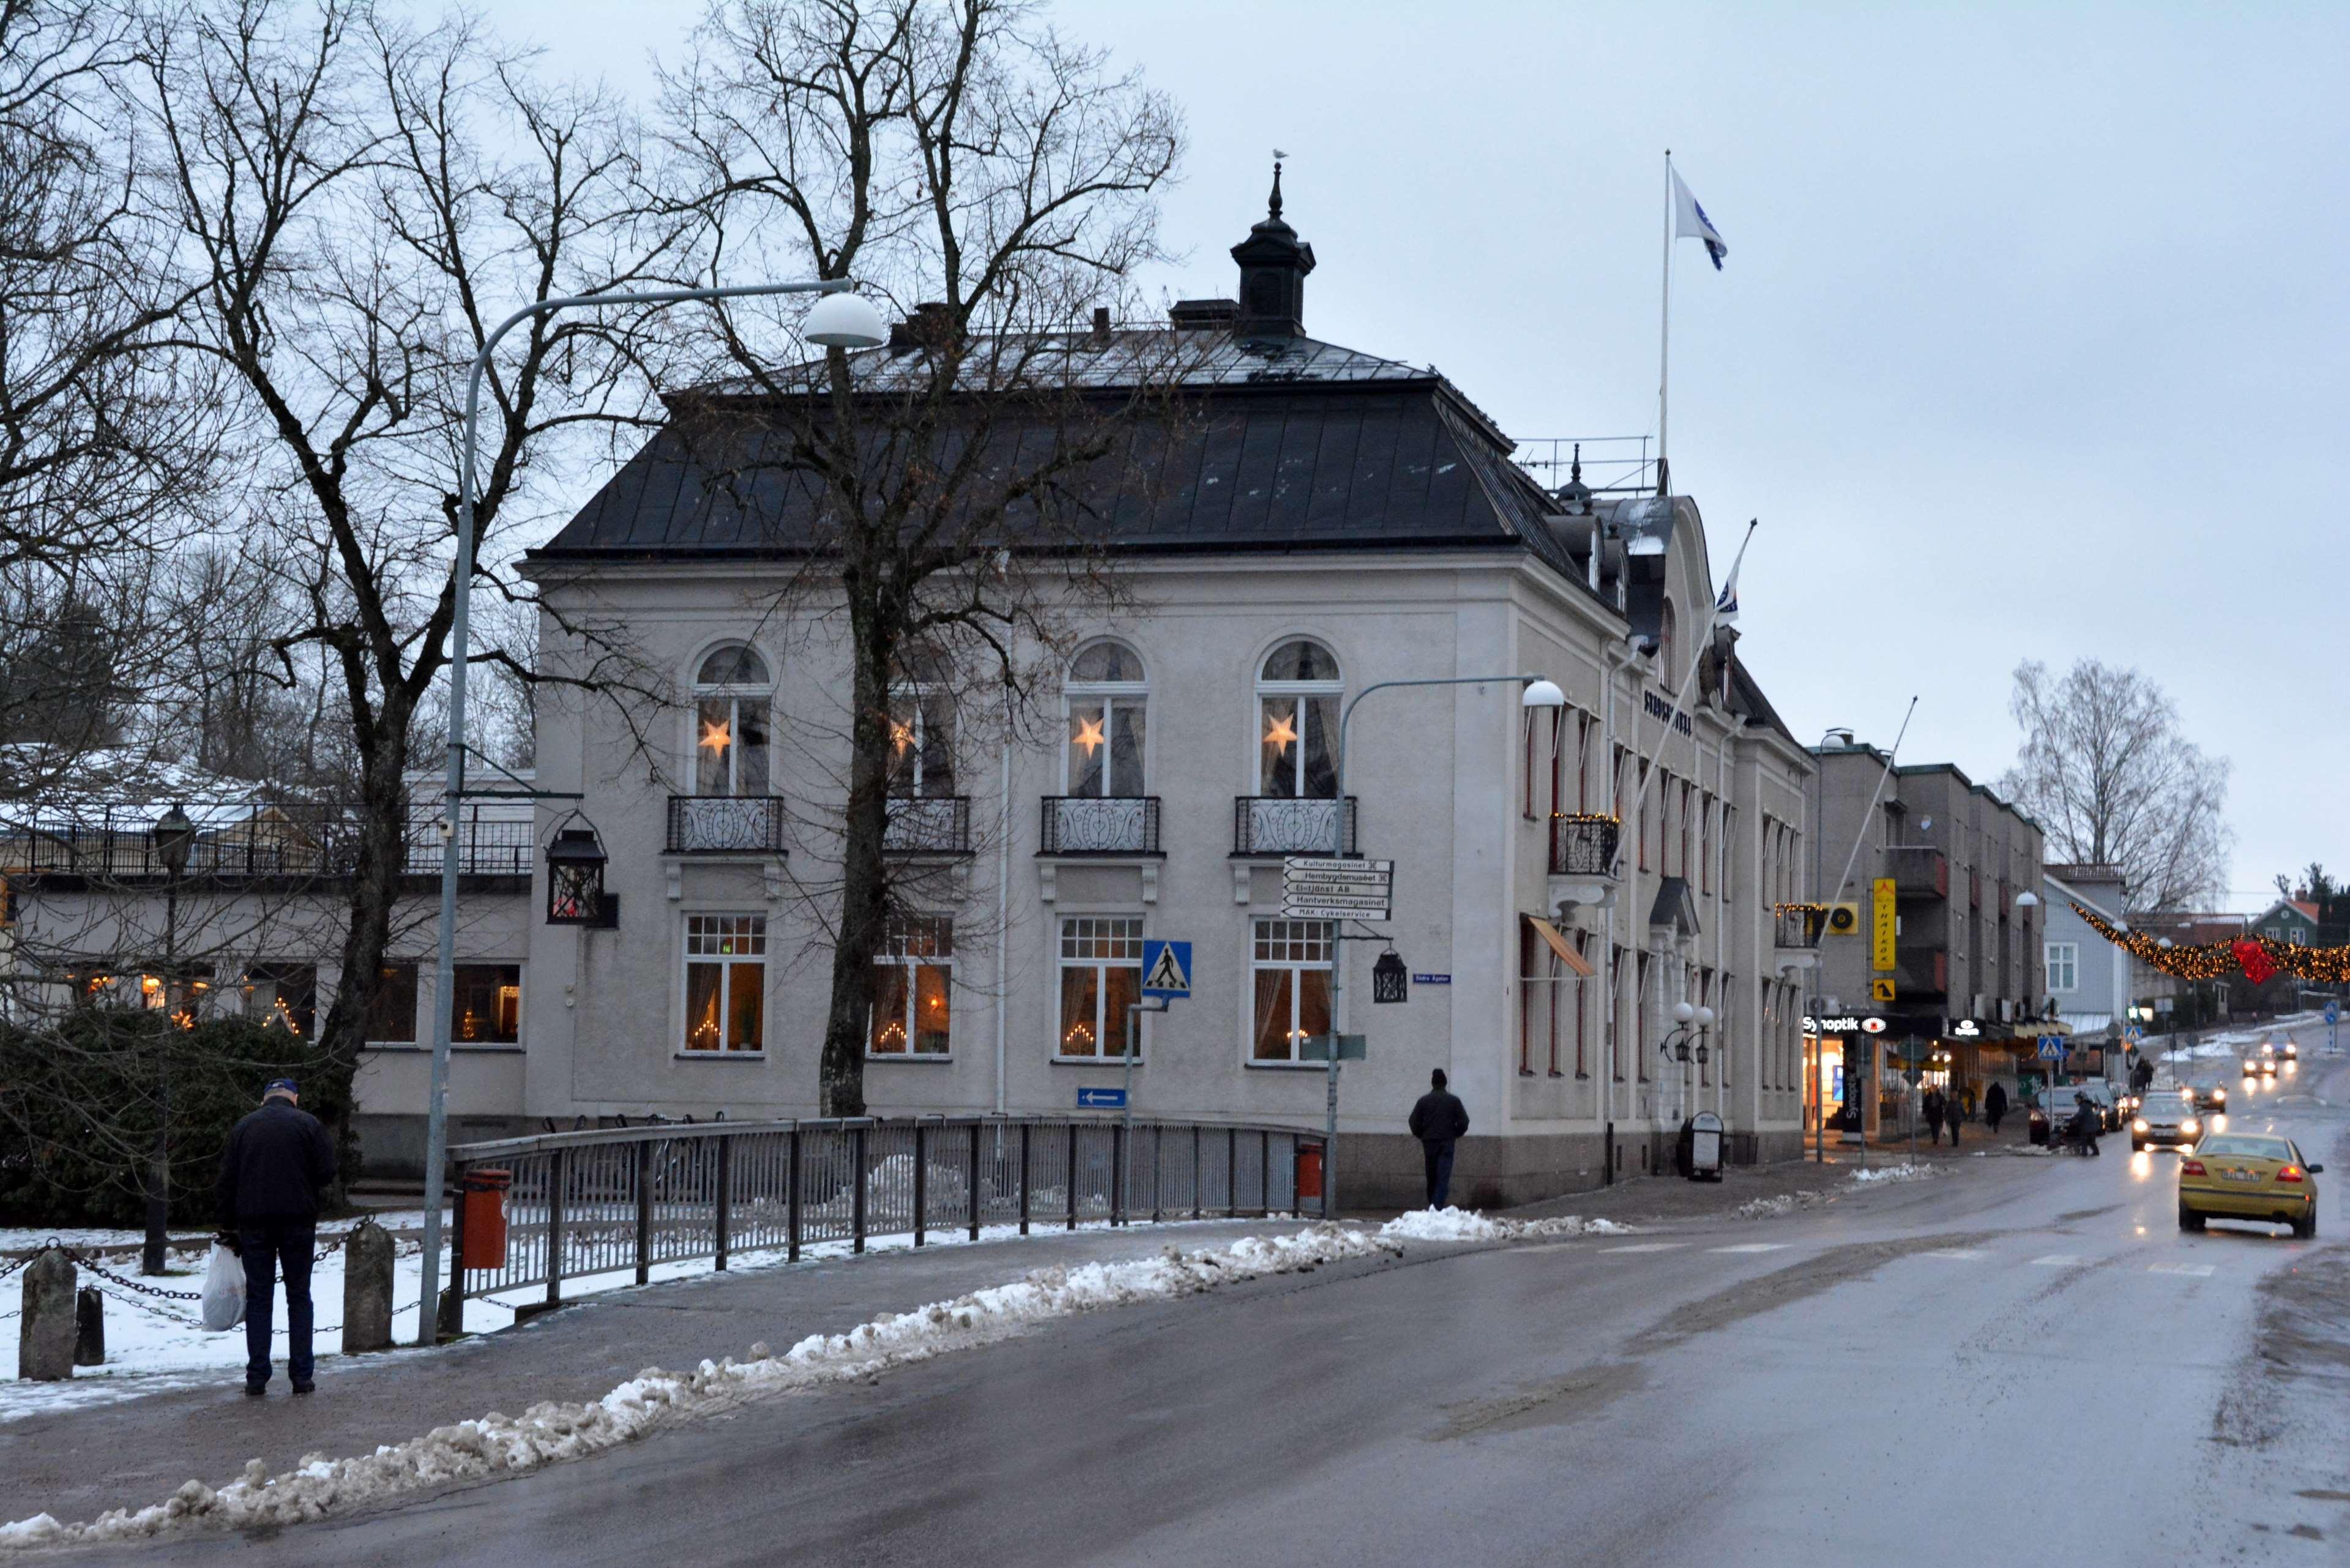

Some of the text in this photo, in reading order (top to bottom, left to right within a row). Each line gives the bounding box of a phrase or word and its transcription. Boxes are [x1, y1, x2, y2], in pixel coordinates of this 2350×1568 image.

[1304, 861, 1365, 870] Kulturmagasinet
[1297, 896, 1384, 907] Hantverksmagasinet
[1321, 909, 1370, 918] Cykelservice
[1802, 1017, 1859, 1032] Synoptik
